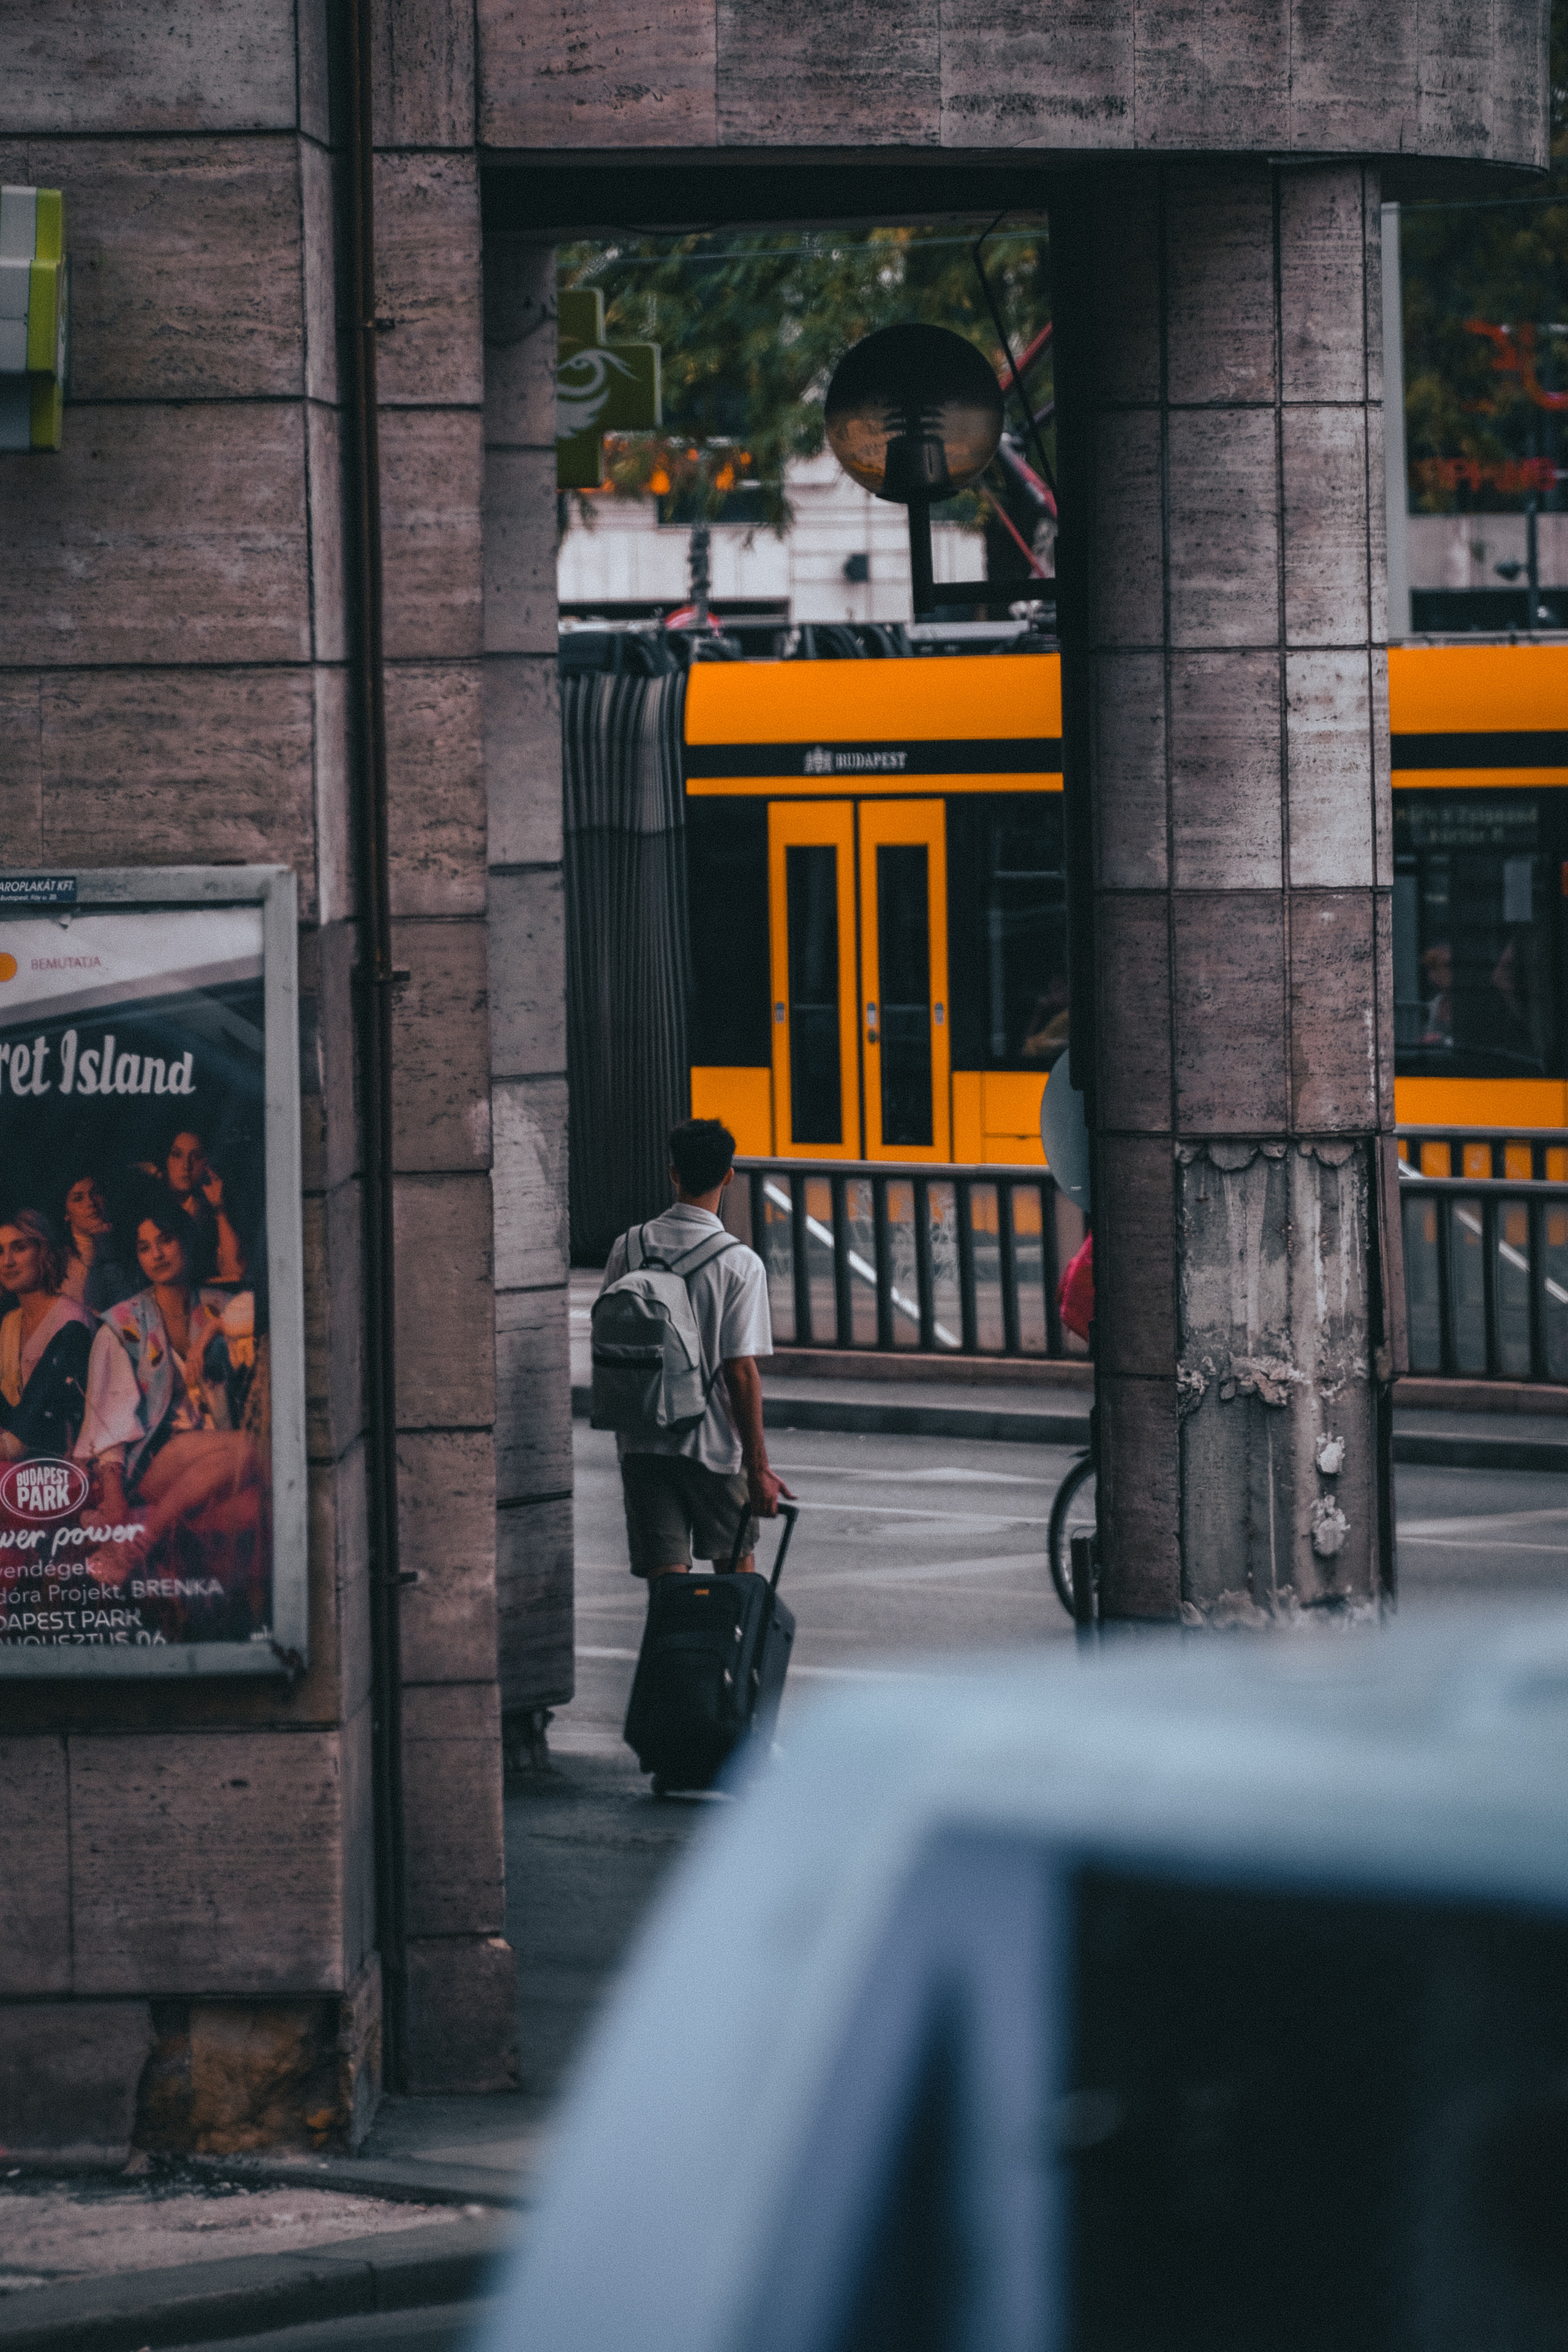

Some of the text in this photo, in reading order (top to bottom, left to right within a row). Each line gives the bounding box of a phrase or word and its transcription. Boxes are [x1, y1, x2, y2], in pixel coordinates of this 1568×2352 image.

[835, 752, 906, 769] BUDAPEST
[31, 957, 101, 970] BEMUTATJA
[59, 1029, 195, 1095] Island
[17, 1467, 69, 1487] BUDAPEST
[17, 1485, 70, 1511] PARK
[51, 1525, 145, 1557] power
[0, 1556, 102, 1580] endégek:
[130, 1578, 224, 1598] BRENKA
[81, 1608, 142, 1629] PARK
